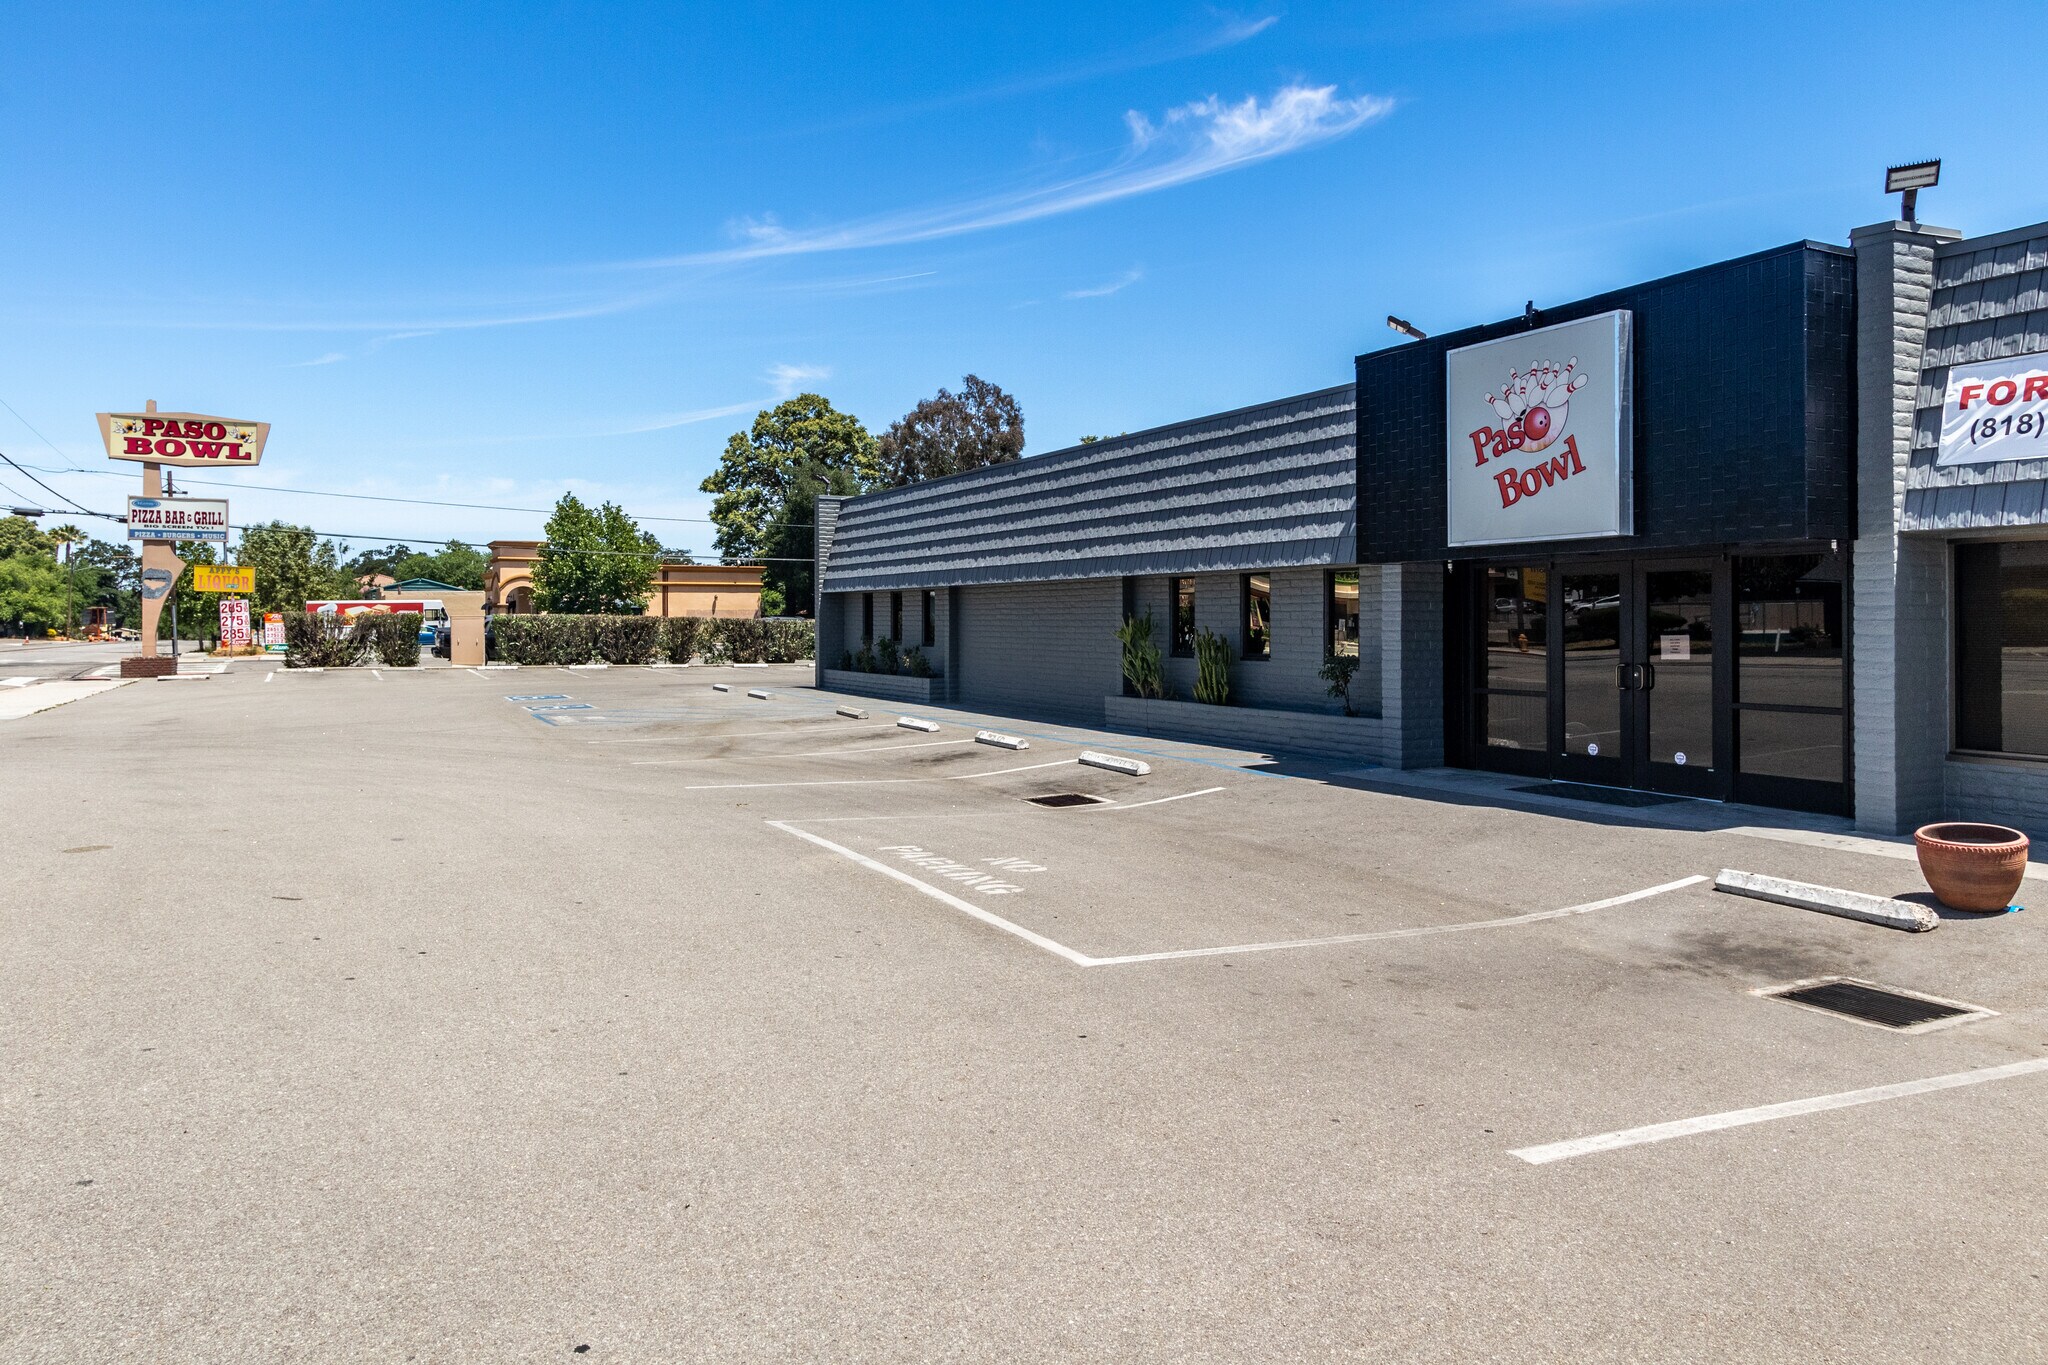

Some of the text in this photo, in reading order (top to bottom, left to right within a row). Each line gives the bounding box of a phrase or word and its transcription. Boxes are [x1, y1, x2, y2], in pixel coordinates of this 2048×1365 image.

[1959, 376, 2048, 410] FOR
[142, 419, 227, 440] PASO
[1970, 412, 2045, 445] (818)
[123, 437, 251, 460] BOWL
[1494, 434, 1586, 509] Bowl
[131, 510, 162, 523] PIZZA
[165, 511, 185, 524] BAR
[194, 511, 224, 525] GRILL
[198, 575, 249, 590] LIQUOR
